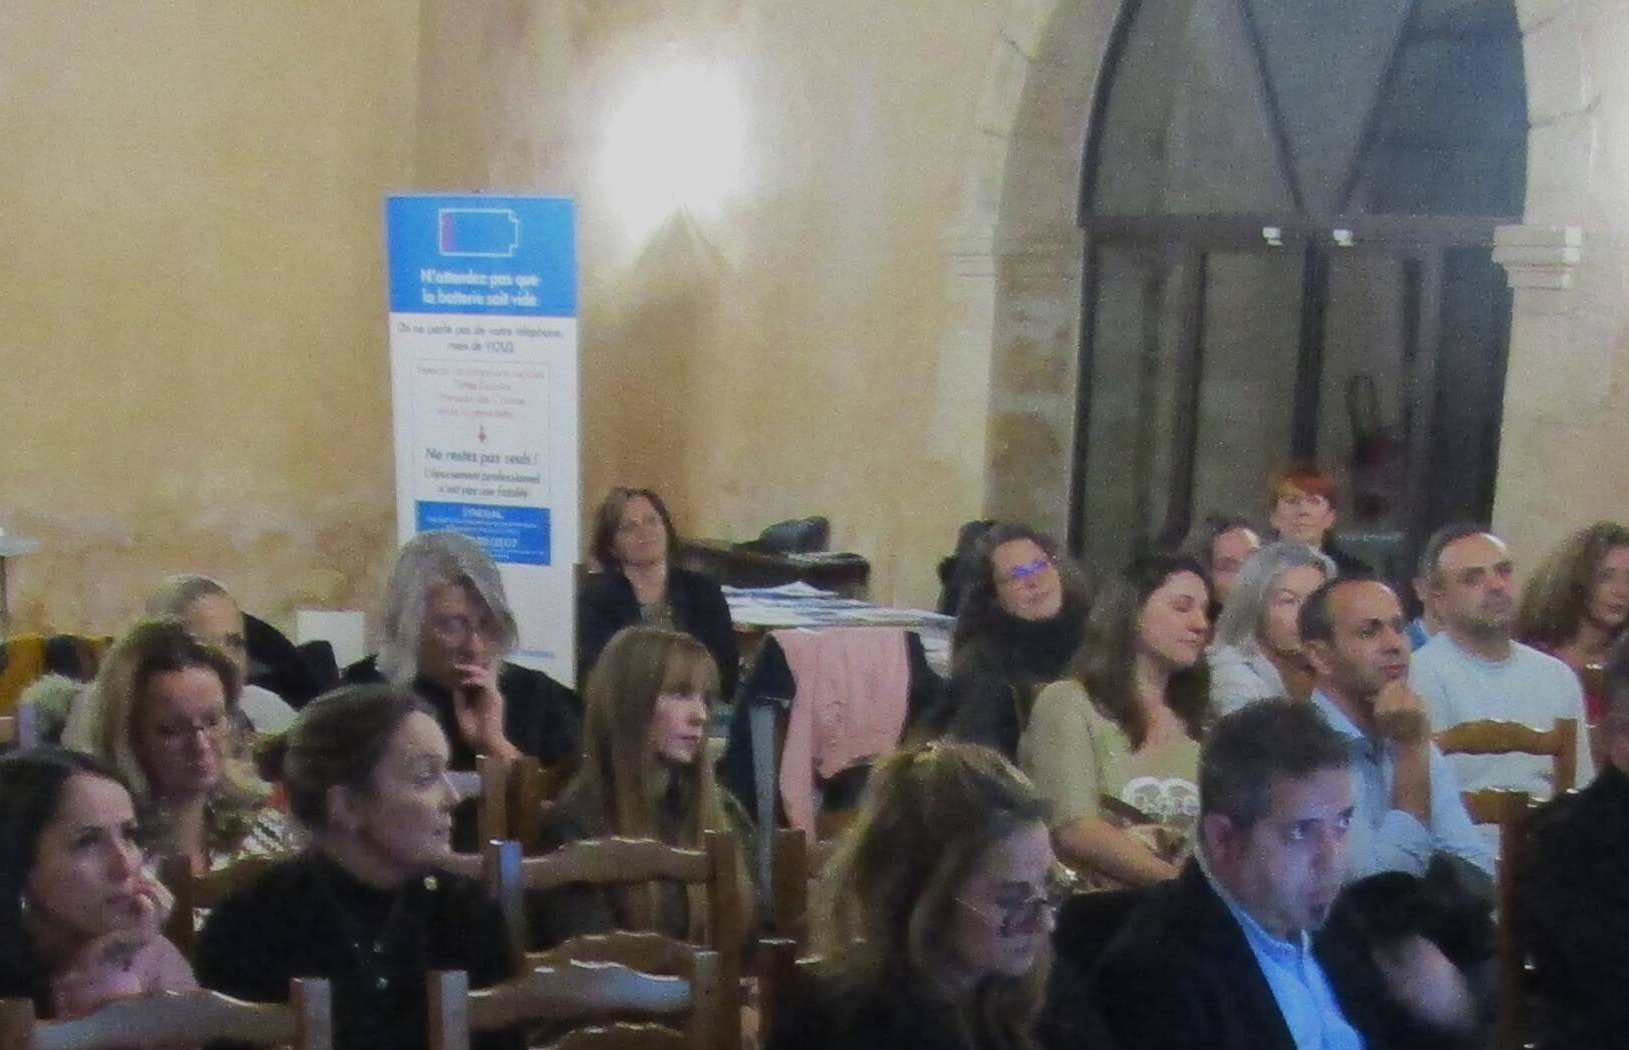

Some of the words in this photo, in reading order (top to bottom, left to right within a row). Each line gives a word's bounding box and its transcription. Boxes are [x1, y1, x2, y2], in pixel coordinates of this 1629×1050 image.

[490, 273, 512, 289] pas
[514, 274, 539, 289] que
[422, 287, 435, 304] la
[437, 287, 484, 305] batterie
[511, 290, 537, 307] vide
[426, 448, 443, 461] Ne
[445, 450, 477, 463] restez
[480, 453, 500, 467] pas
[504, 448, 531, 465] seuls
